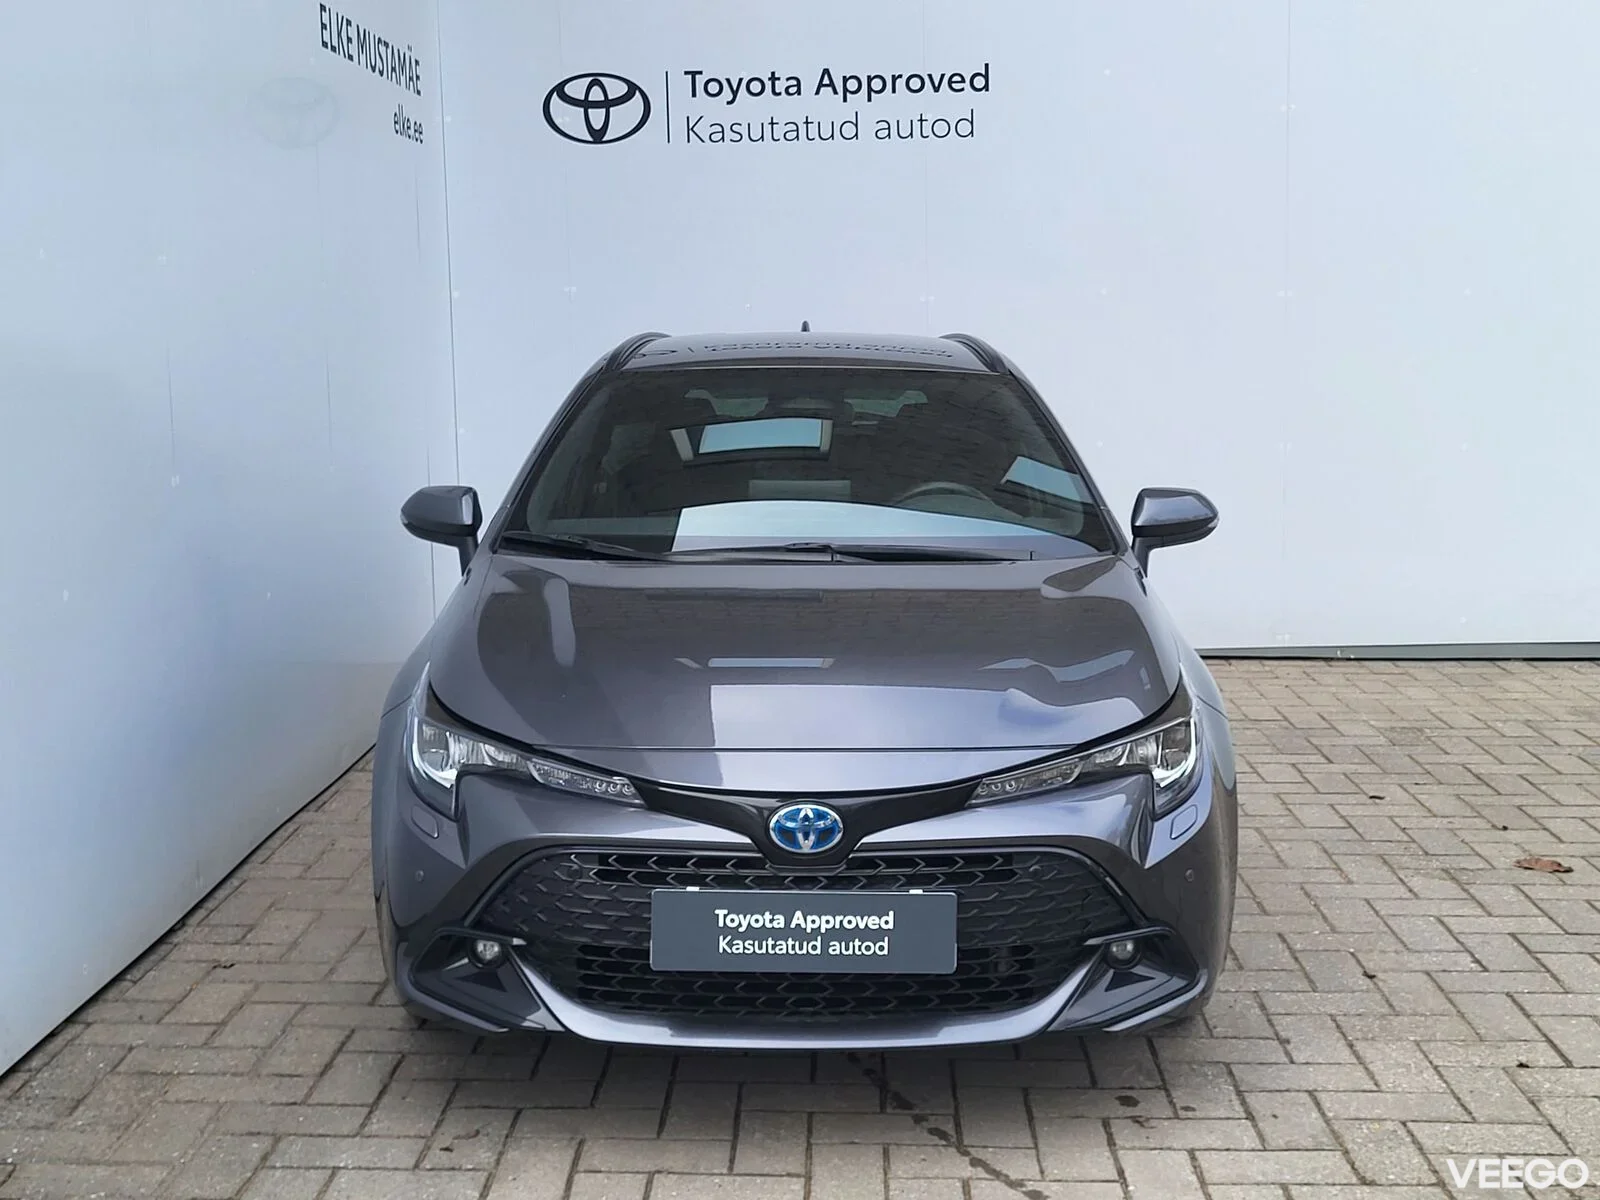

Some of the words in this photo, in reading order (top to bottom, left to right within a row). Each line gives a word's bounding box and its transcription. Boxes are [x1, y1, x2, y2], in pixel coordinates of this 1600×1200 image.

[319, 2, 354, 62] ELKE
[356, 24, 421, 97] MUSTAMÄE
[684, 69, 802, 105] Toyota
[814, 63, 991, 102] Approved
[393, 103, 424, 144] elke.ee
[686, 112, 860, 144] Kasutatud
[874, 109, 975, 141] autod
[714, 909, 785, 932] Toyota
[790, 910, 894, 933] Approved
[718, 935, 822, 956] Kasutatud
[828, 936, 889, 956] autod
